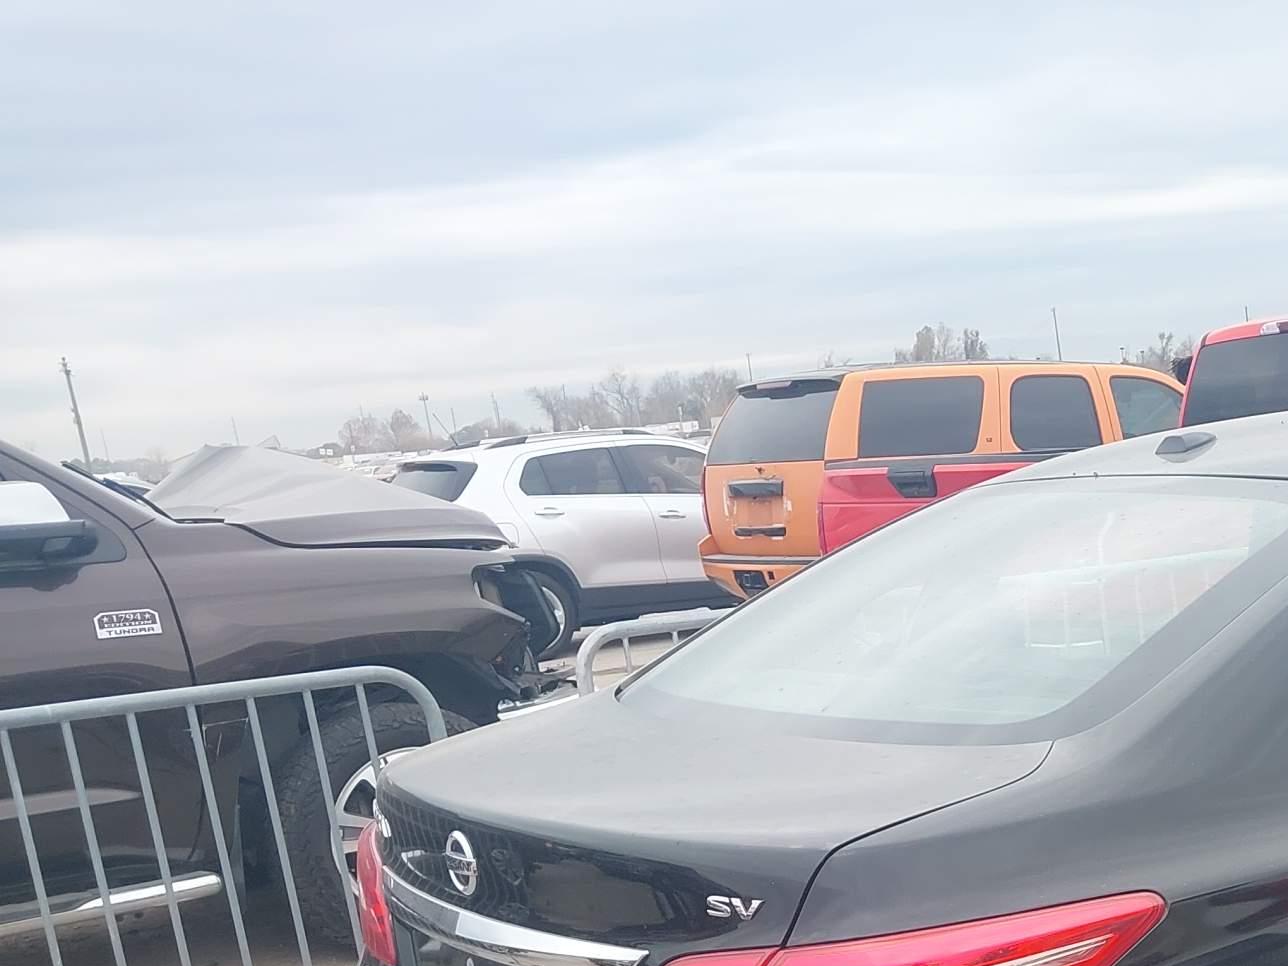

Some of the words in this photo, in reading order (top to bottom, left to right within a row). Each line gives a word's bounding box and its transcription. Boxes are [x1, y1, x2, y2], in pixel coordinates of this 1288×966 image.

[112, 612, 142, 622] 1794
[106, 626, 155, 636] TUNDRA
[706, 895, 765, 921] SV
